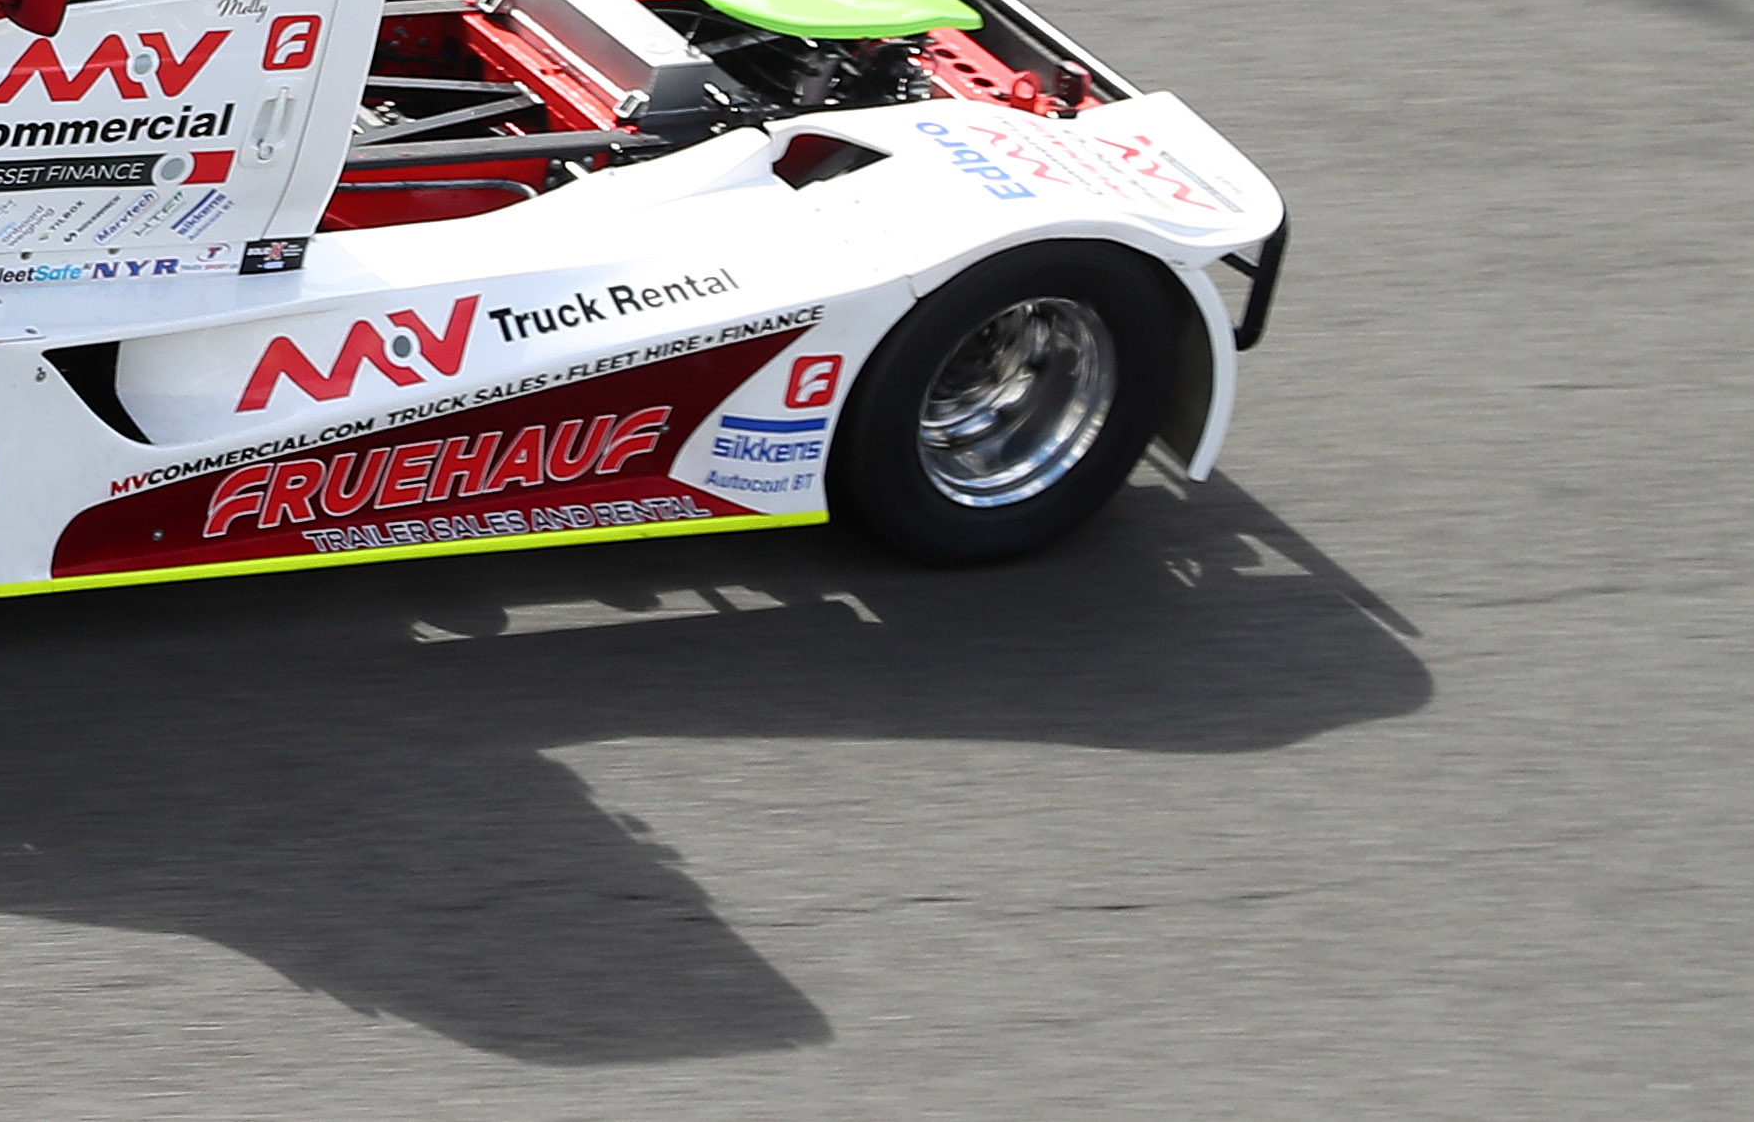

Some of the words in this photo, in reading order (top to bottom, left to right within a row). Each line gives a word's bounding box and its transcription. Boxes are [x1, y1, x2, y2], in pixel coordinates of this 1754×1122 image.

[45, 160, 146, 182] FINANCE
[915, 121, 1038, 201] Edbro
[91, 258, 180, 279] NYR
[488, 291, 607, 343] Truck
[608, 267, 741, 317] Rental
[234, 294, 480, 413] MV
[109, 417, 375, 497] MVCOMMERCIAL.COM
[387, 392, 468, 427] TRUCK
[472, 373, 549, 406] SALES
[567, 350, 639, 382] FLEET
[646, 335, 701, 362] HIRE
[718, 304, 825, 343] FINANCE
[203, 405, 673, 538] FRUEHAUF
[712, 434, 824, 464] sikkens
[302, 519, 432, 553] TRAILER
[431, 509, 530, 539] SALES
[531, 504, 592, 531] AND
[592, 495, 712, 526] RENTAL
